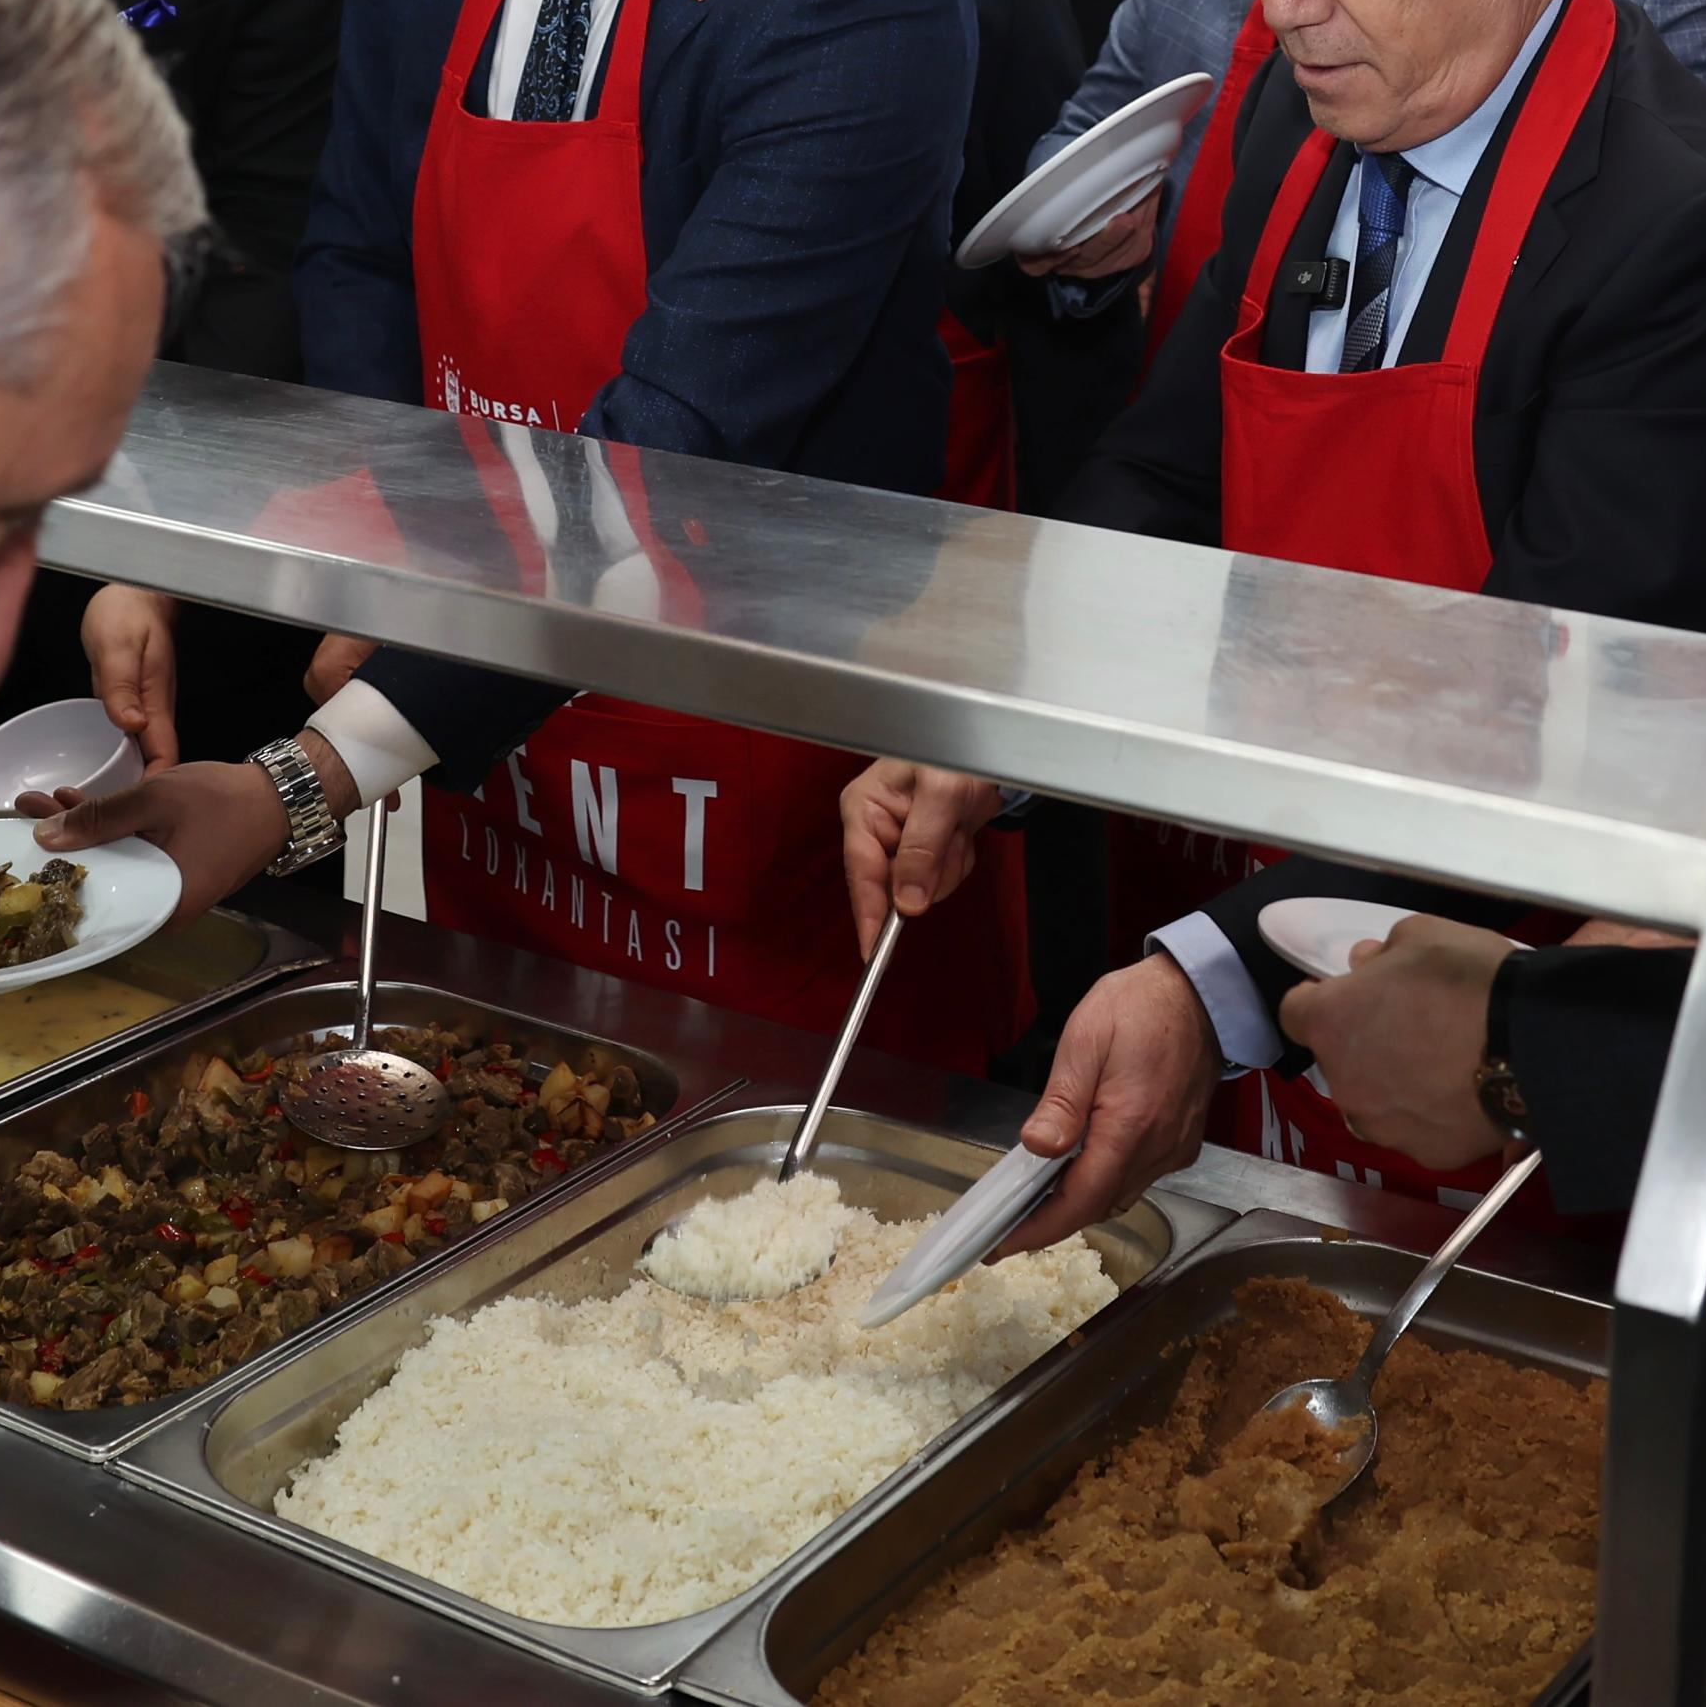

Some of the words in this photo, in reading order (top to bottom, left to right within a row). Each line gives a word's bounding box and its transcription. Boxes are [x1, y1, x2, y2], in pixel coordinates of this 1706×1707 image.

[470, 389, 542, 425] BURSA
[473, 743, 718, 891] ENT
[459, 811, 715, 978] LOKANTASI
